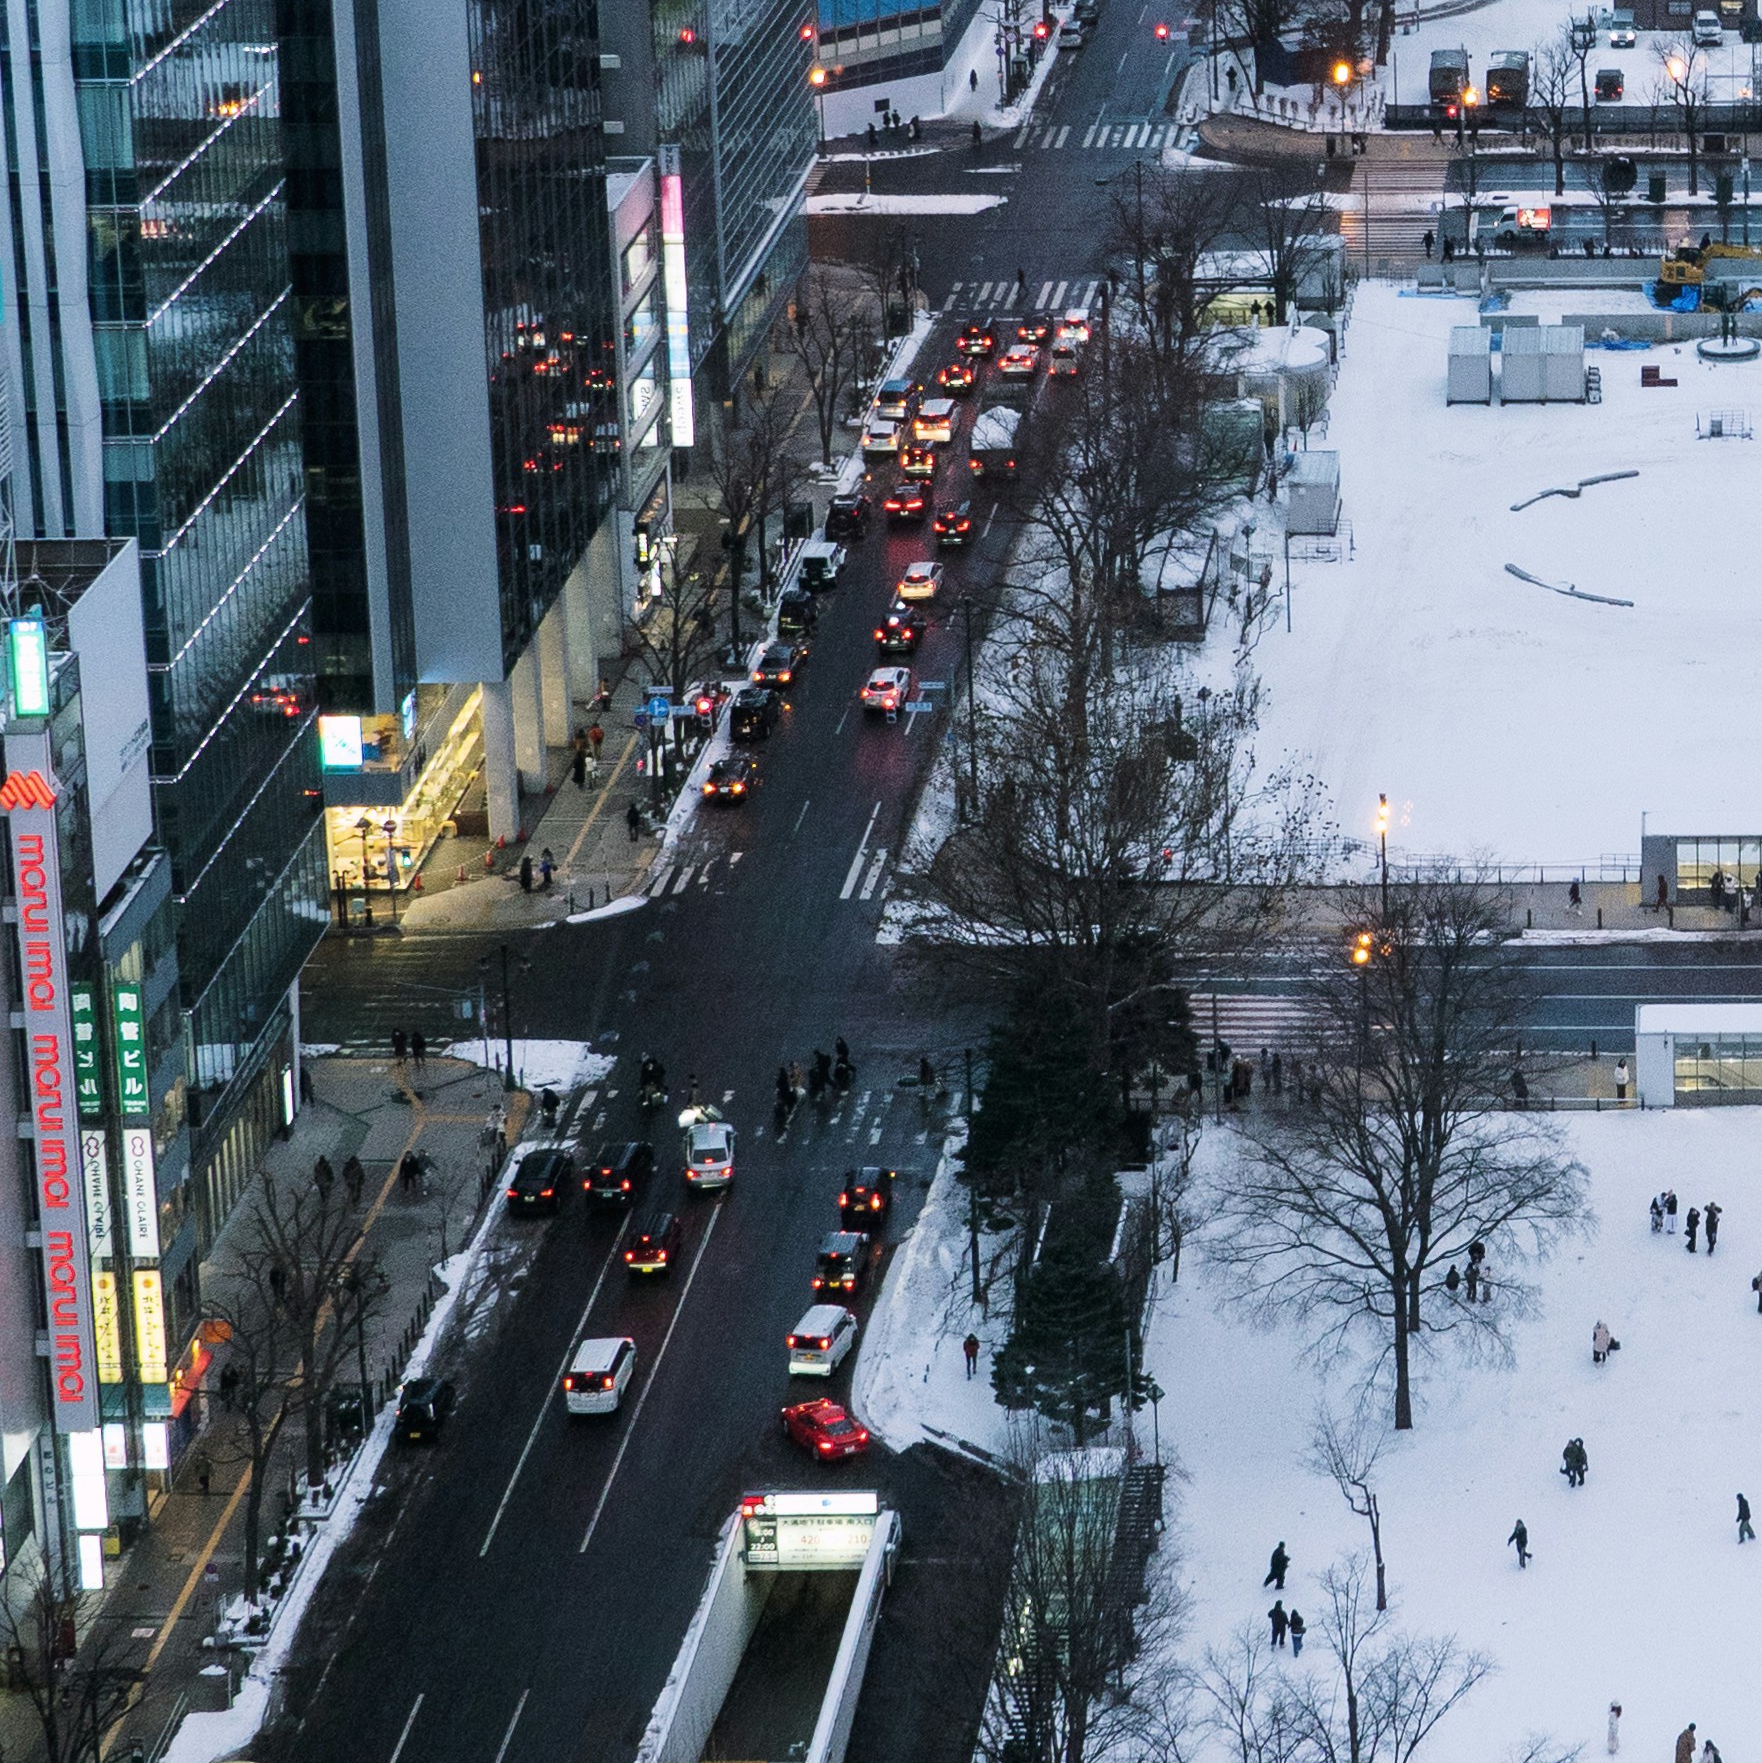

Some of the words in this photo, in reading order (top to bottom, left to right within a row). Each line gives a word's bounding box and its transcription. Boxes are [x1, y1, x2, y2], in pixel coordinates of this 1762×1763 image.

[19, 835, 49, 932] marui
[26, 941, 55, 1011] imai
[33, 1034, 63, 1131] marui
[41, 1139, 69, 1209] imai
[48, 1231, 78, 1326] marui
[56, 1334, 84, 1403] imai
